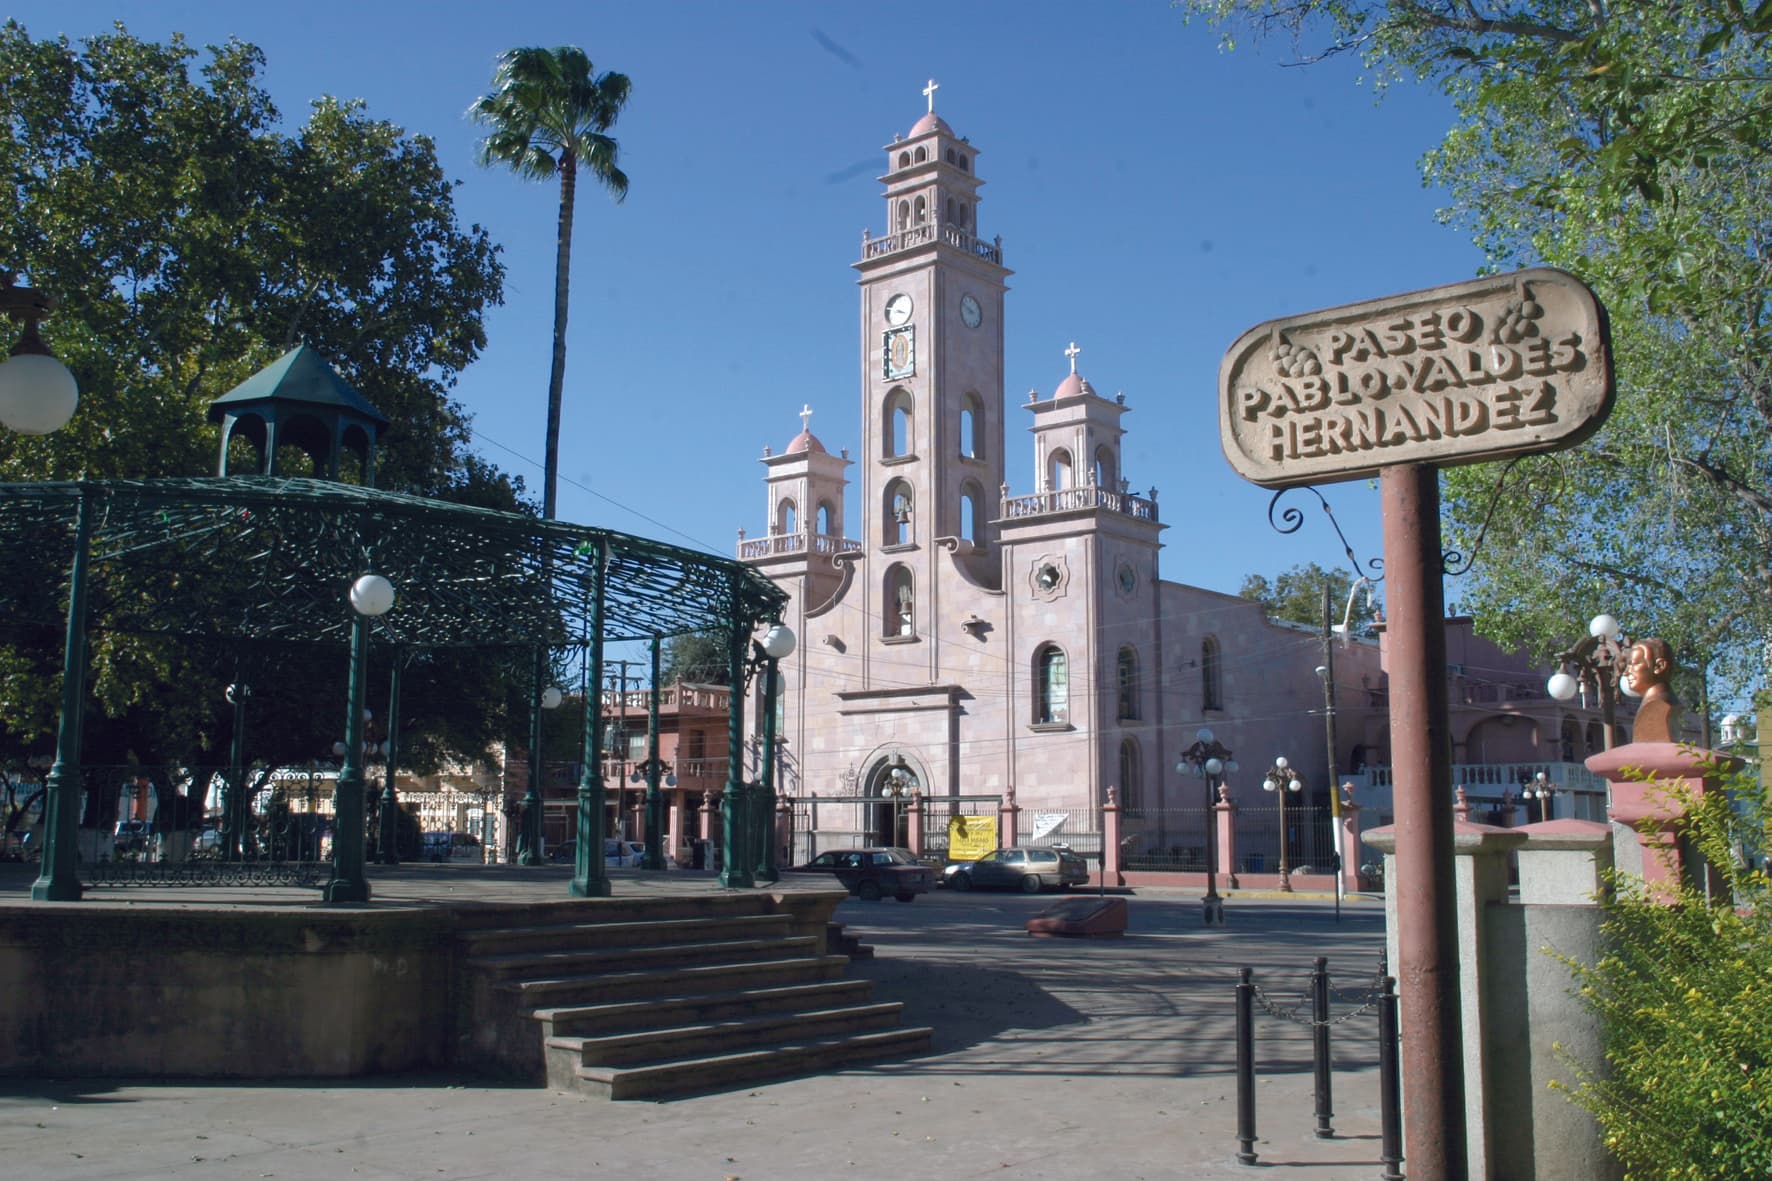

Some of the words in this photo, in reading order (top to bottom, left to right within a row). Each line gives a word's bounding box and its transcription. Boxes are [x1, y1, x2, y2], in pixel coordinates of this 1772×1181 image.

[1328, 306, 1483, 365] PASEO
[1401, 332, 1586, 394] VALDES
[1270, 380, 1558, 460] HERNANDEZ
